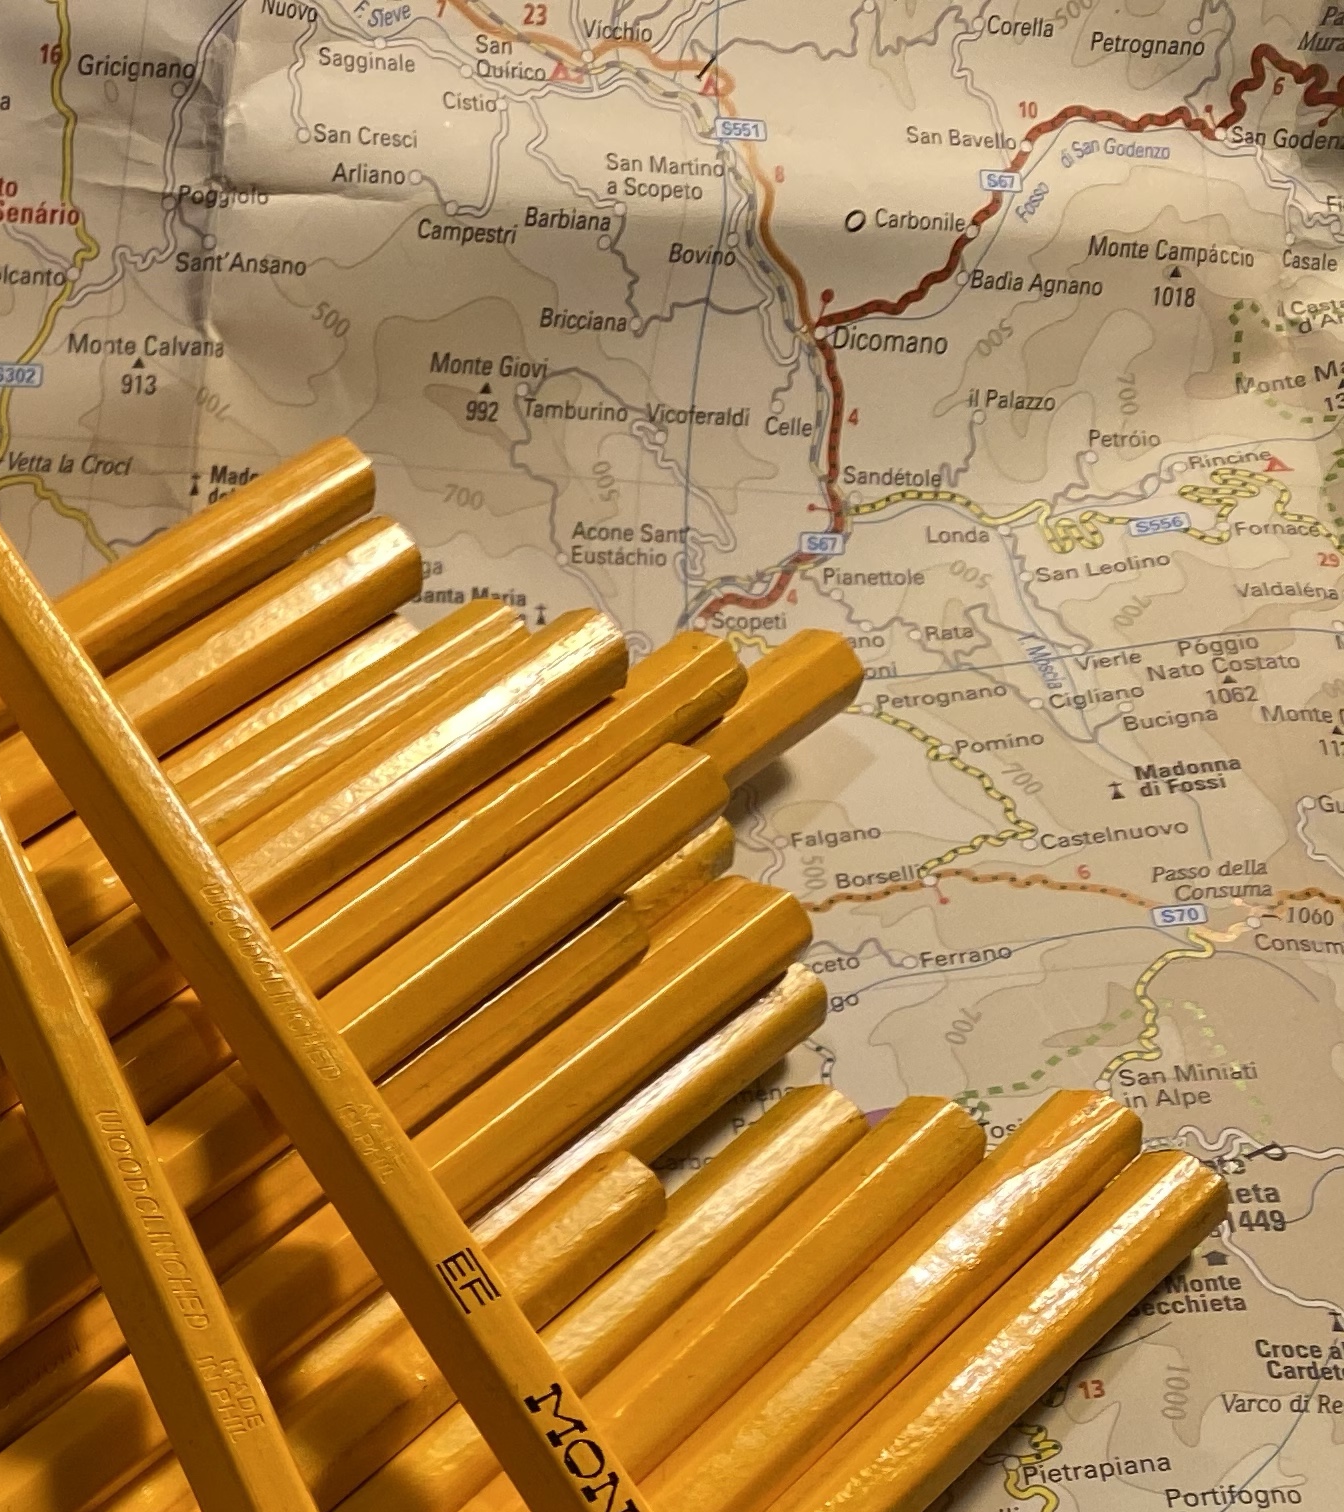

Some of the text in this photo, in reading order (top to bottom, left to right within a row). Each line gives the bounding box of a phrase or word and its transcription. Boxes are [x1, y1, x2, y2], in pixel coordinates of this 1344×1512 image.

[78, 55, 195, 82] Gricignano
[875, 209, 966, 233] Carbonile
[418, 221, 517, 247] Campestri
[971, 269, 1103, 299] Badia Agnano
[1152, 286, 1195, 309] 1018
[833, 325, 947, 356] Dicomano
[121, 373, 156, 396] 913
[467, 400, 500, 422] 992
[956, 731, 1044, 755] Pomino
[1135, 756, 1241, 781] Madonna
[1140, 774, 1225, 798] di Fossi
[1040, 820, 1188, 851] Castelnuovo
[1162, 906, 1198, 924] S70
[437, 1248, 501, 1314] EF
[1022, 1453, 1172, 1488] Pietrapiana
